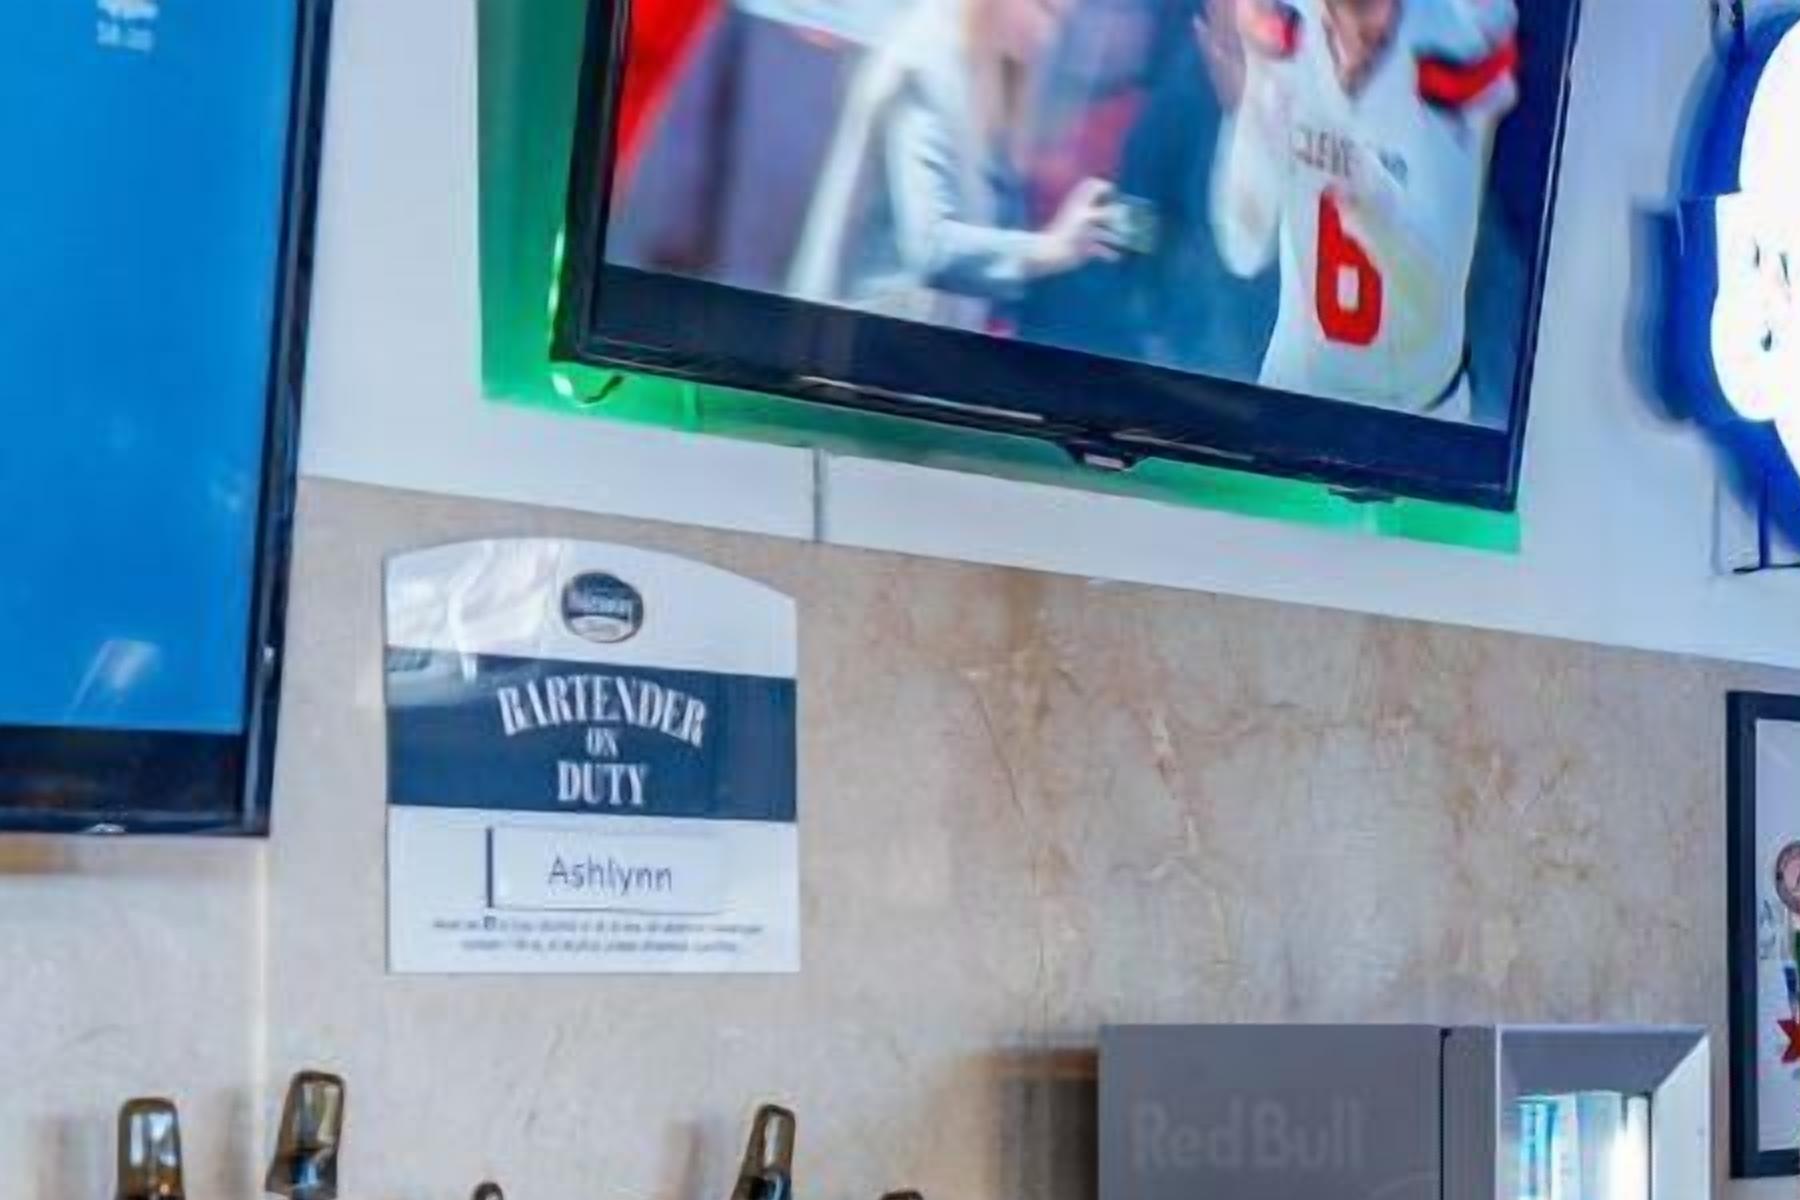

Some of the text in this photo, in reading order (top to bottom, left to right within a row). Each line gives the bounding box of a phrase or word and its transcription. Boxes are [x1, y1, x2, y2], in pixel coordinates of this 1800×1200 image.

[1314, 186, 1383, 346] 6
[497, 672, 707, 748] BARTENDER
[556, 760, 647, 805] DUTY
[546, 853, 674, 895] Ashlynn
[1131, 1095, 1364, 1171] Red Bull
